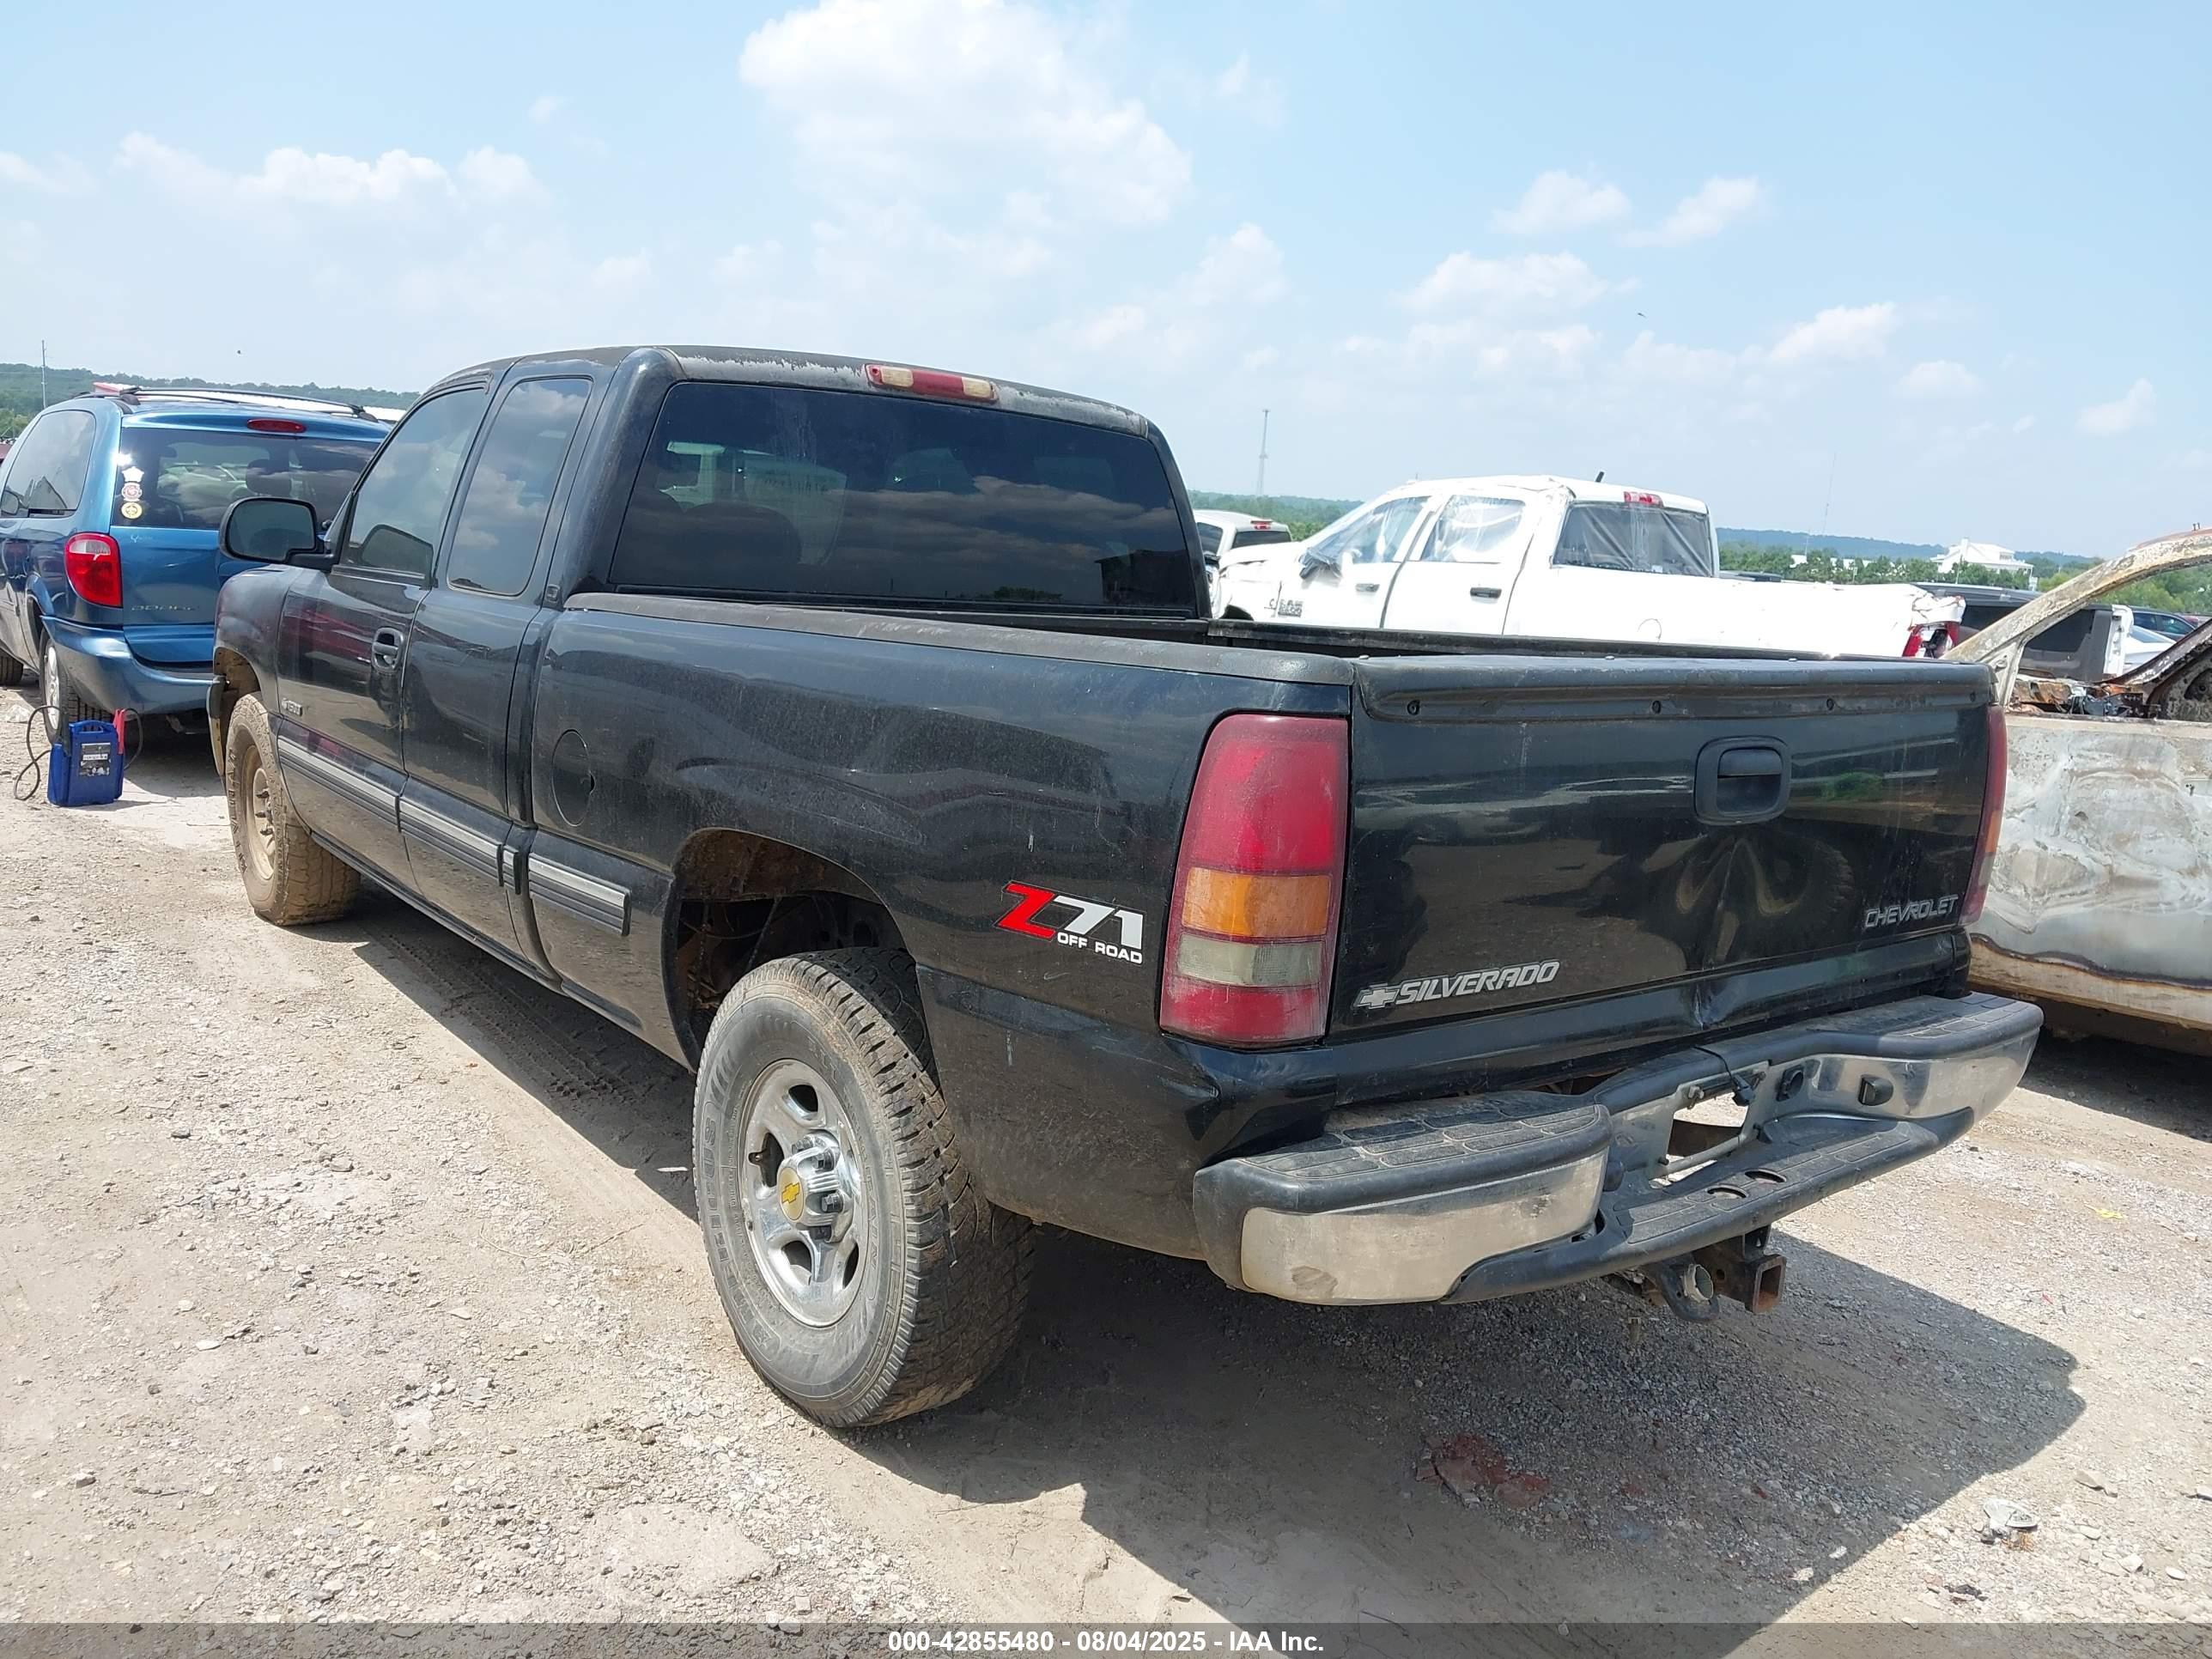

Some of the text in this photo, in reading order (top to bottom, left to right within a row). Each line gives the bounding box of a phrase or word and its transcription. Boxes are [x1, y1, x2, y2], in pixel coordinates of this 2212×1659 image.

[997, 883, 1144, 950] Z71
[1865, 894, 1959, 928] CHEVROLET
[1057, 932, 1143, 964] OFF ROAD
[1395, 960, 1560, 1005] SILVERADO
